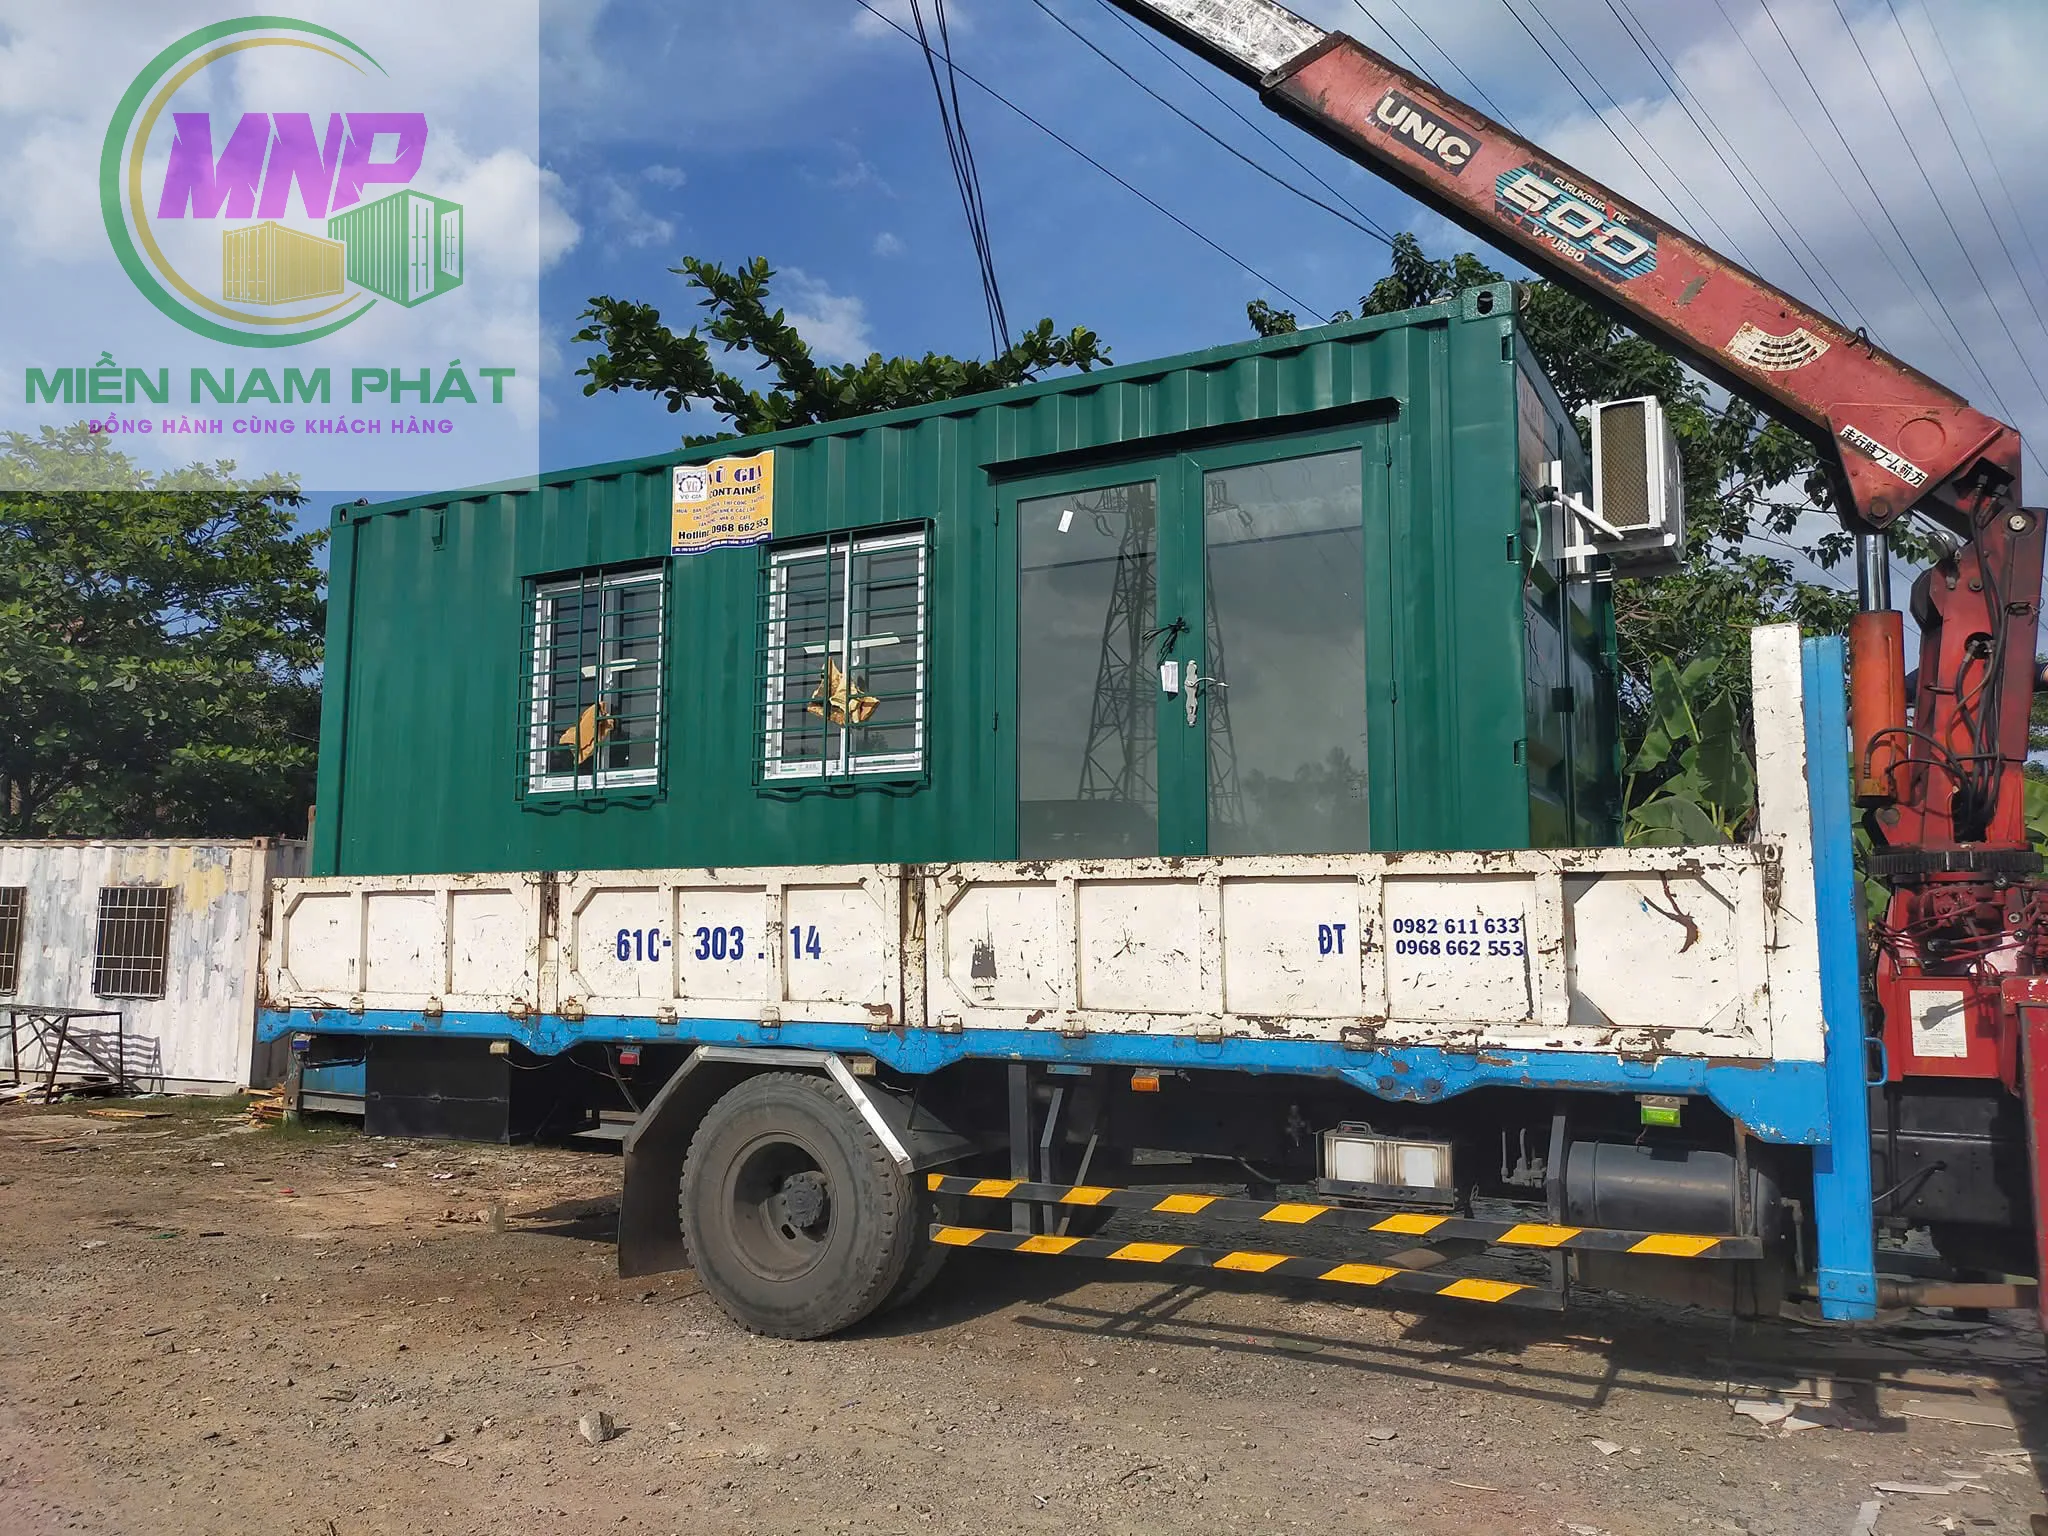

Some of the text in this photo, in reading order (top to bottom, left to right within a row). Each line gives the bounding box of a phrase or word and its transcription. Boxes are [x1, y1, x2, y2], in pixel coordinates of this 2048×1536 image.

[1376, 96, 1472, 166] UNIC
[1553, 176, 1606, 212] FURUKAWA
[1503, 173, 1650, 265] 500
[711, 523, 734, 534] 0968
[738, 522, 755, 531] 662
[790, 925, 822, 960] 14
[1318, 923, 1346, 955] ĐT
[1393, 918, 1520, 934] 0982 611 633
[1396, 940, 1524, 956] 0968 662 553
